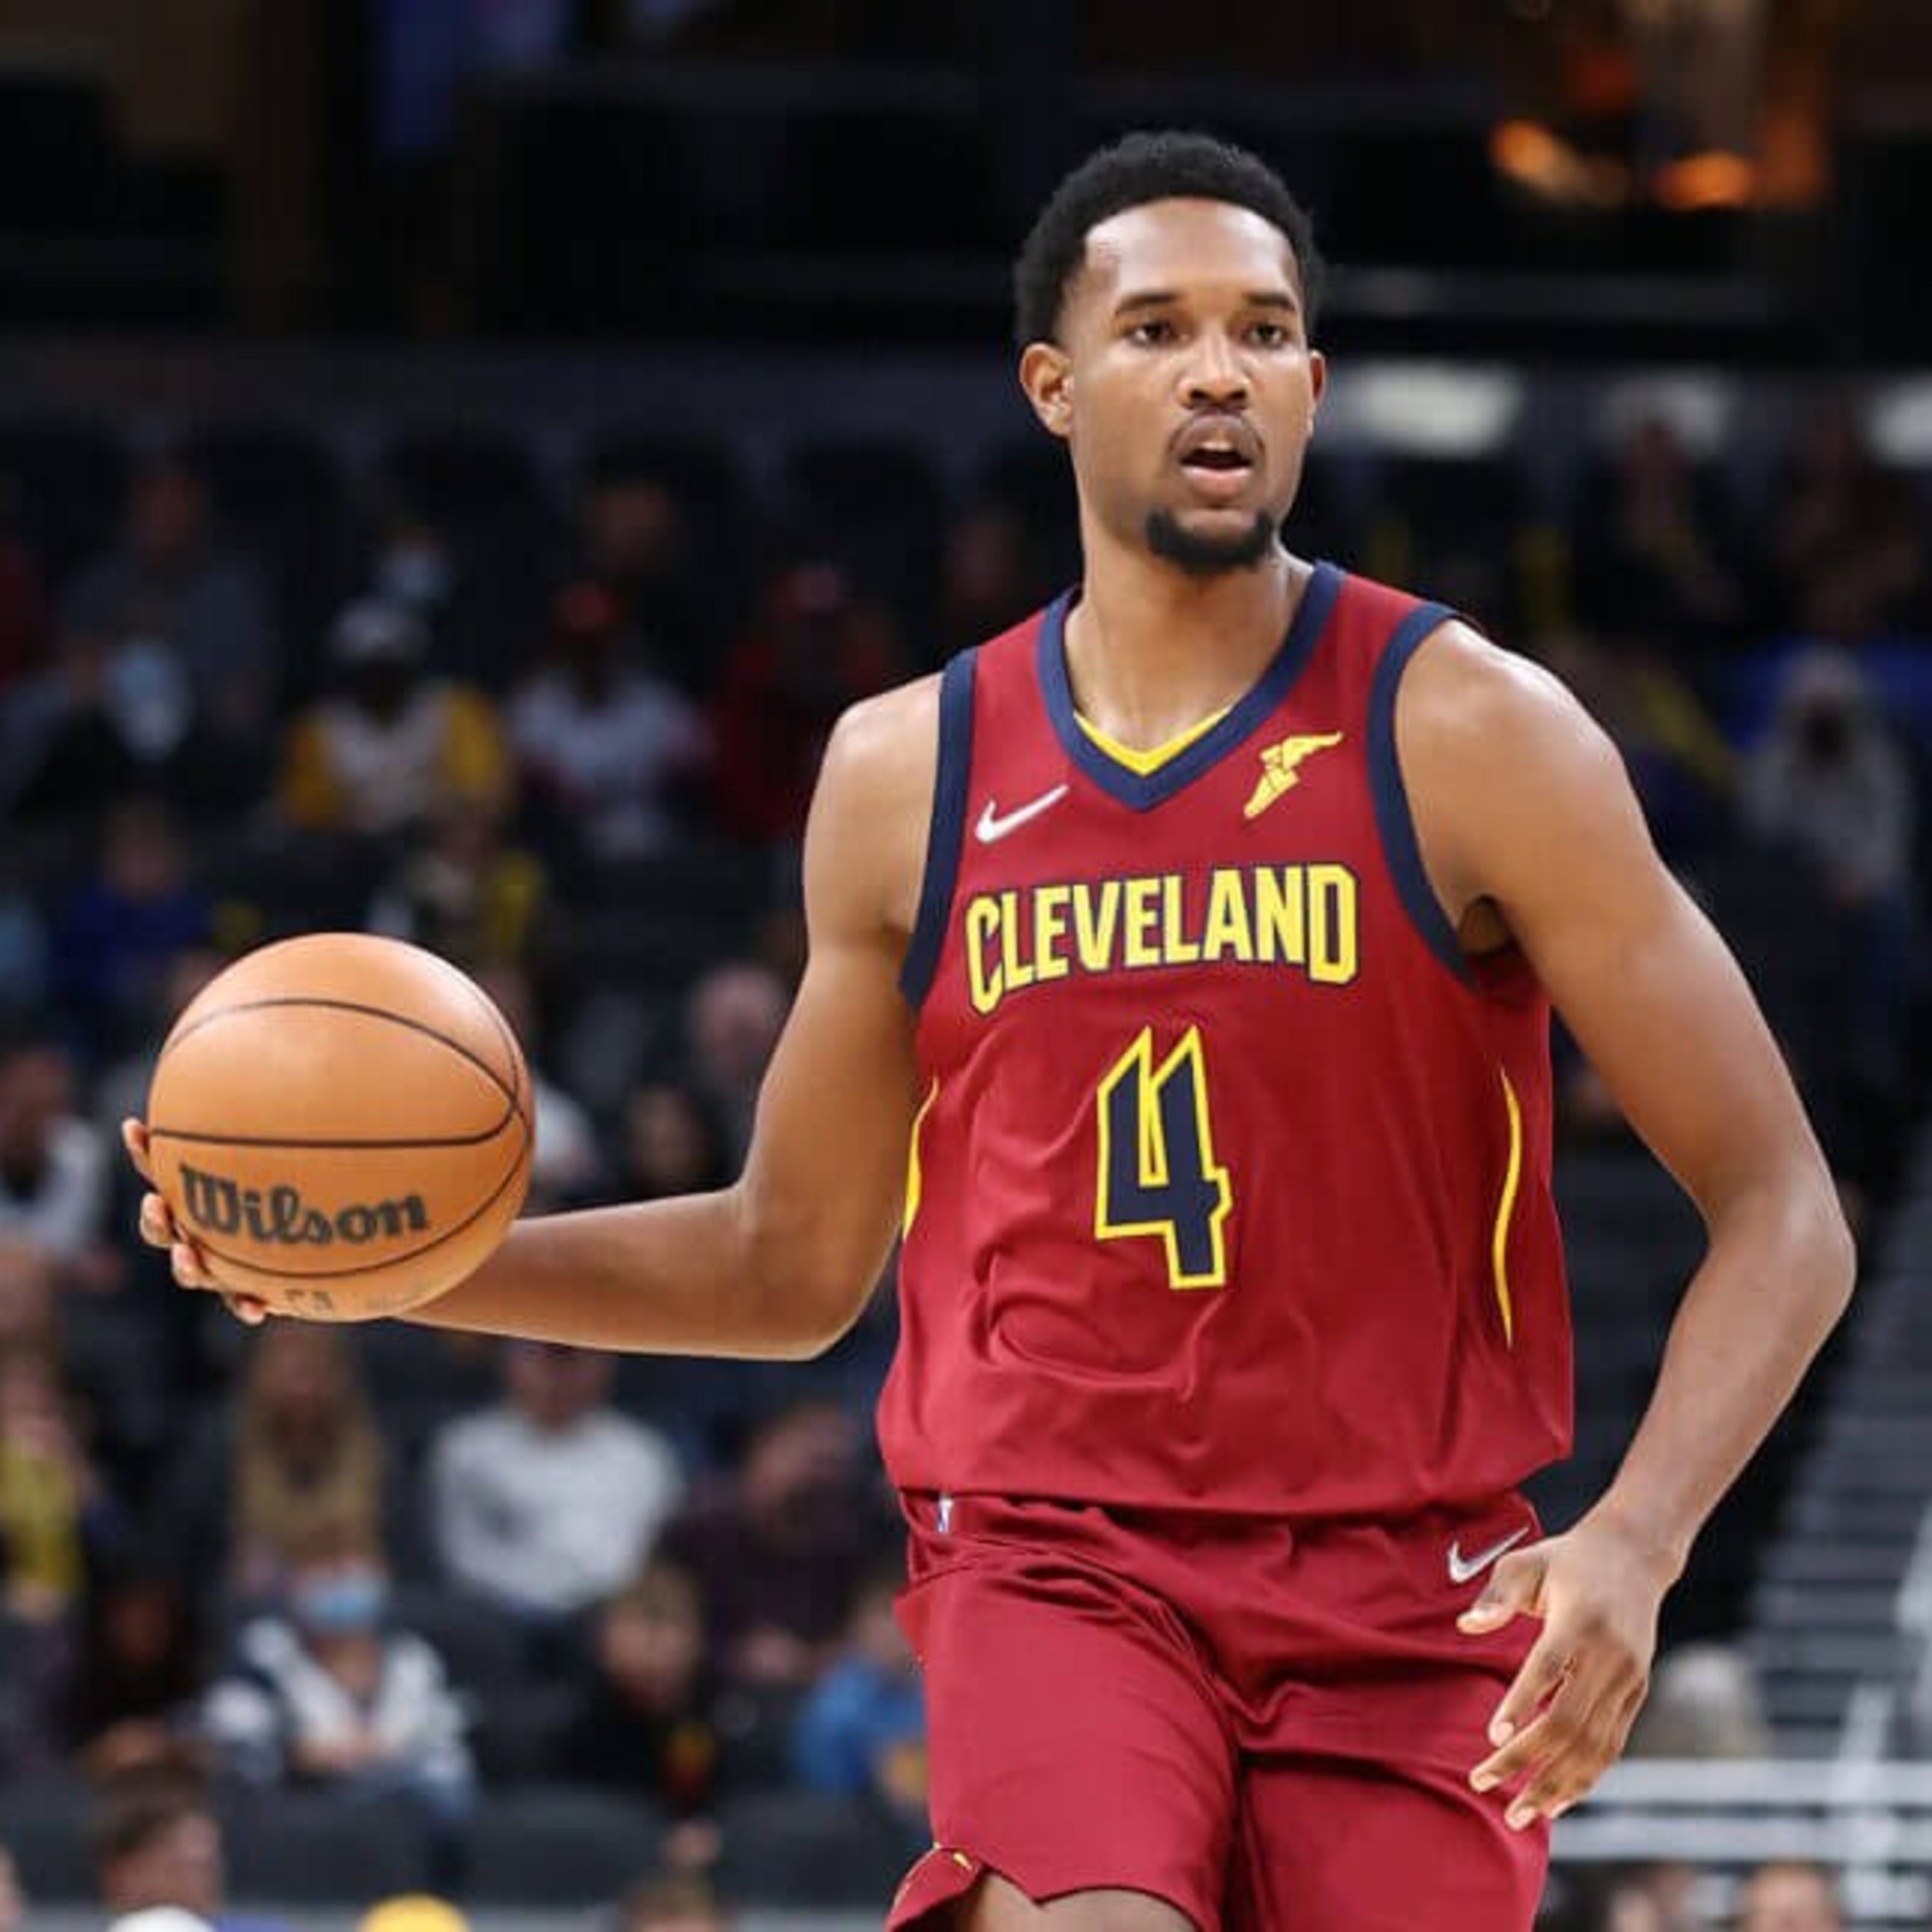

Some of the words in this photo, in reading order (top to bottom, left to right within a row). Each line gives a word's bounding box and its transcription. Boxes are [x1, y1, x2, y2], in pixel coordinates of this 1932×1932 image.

[965, 863, 1358, 1015] CLEVELAND
[179, 1162, 431, 1245] Wilson
[1095, 1025, 1233, 1290] 4
